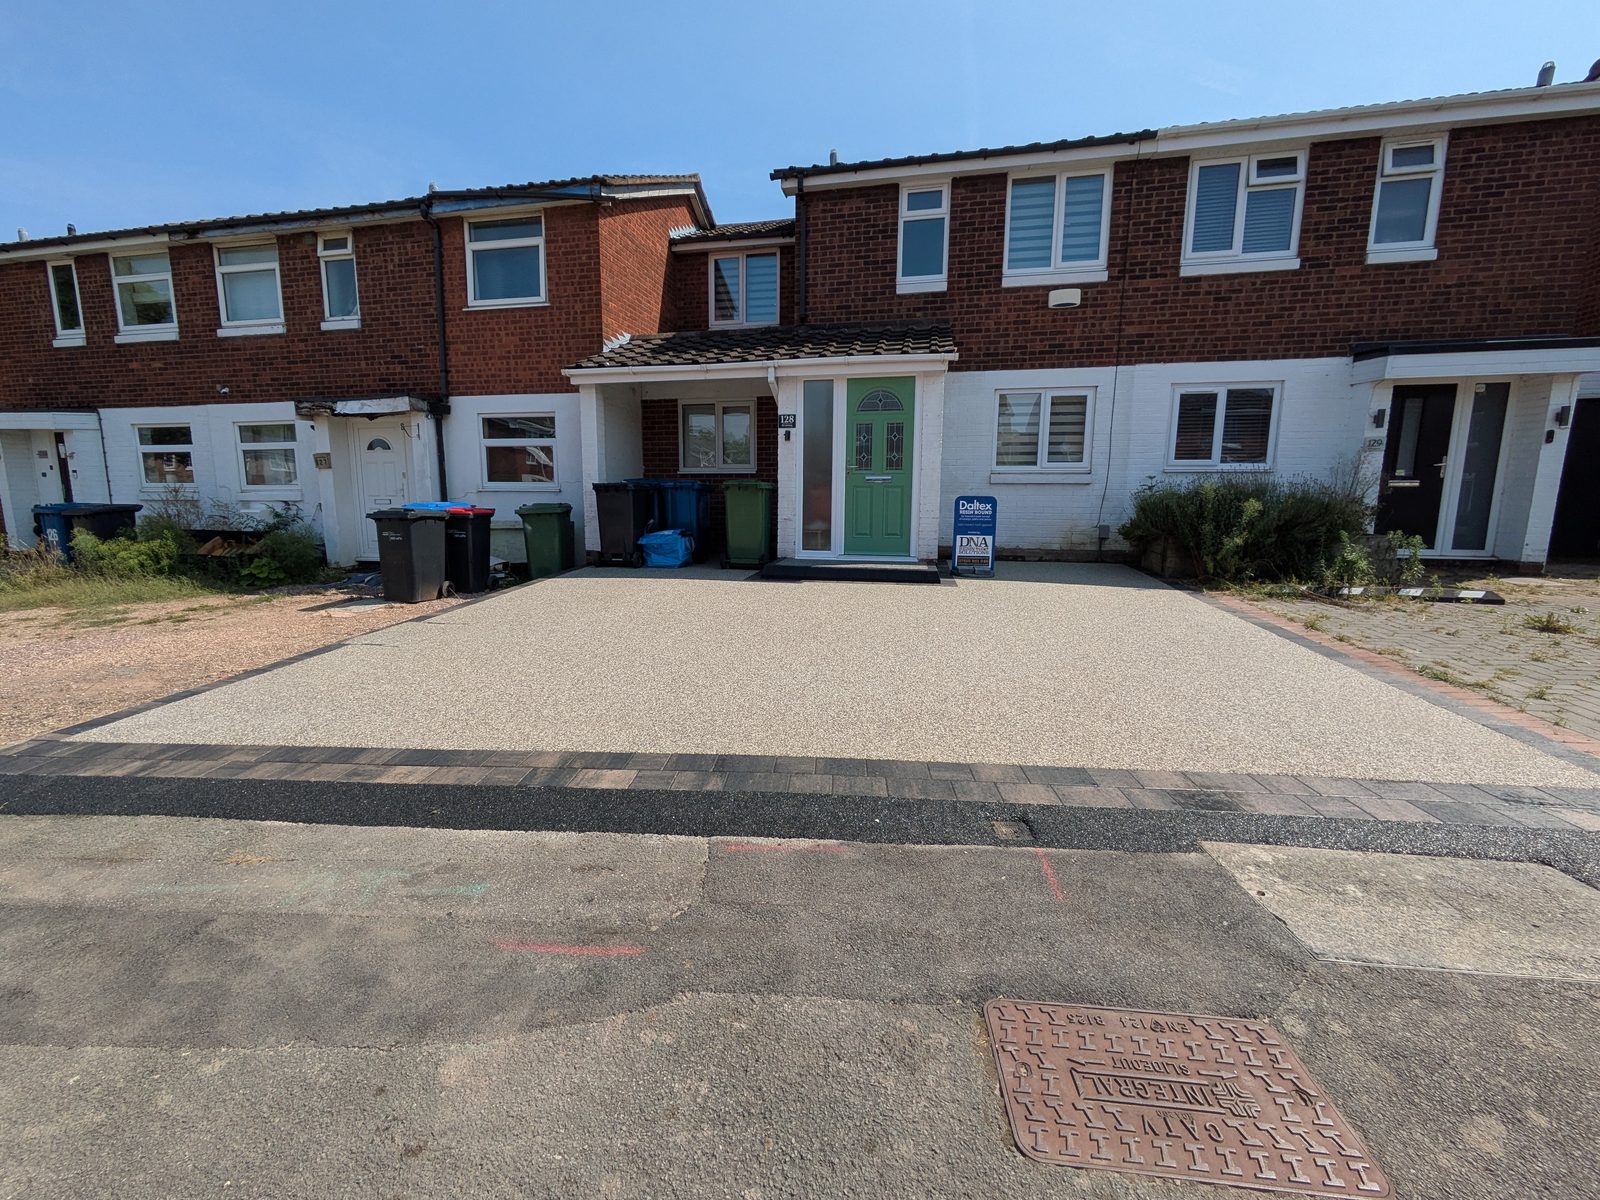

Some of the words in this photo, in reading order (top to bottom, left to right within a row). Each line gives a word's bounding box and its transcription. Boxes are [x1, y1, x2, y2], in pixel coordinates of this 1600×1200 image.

[780, 415, 794, 424] 128
[1368, 438, 1383, 447] 129
[959, 499, 992, 510] Daltex
[960, 536, 988, 548] DNA
[1066, 1013, 1105, 1026] B125
[1165, 1021, 1191, 1034] EN
[1111, 1056, 1191, 1075] SLIDEOUT
[1082, 1075, 1213, 1106] INTEGRAL
[1140, 1114, 1225, 1143] CATV
